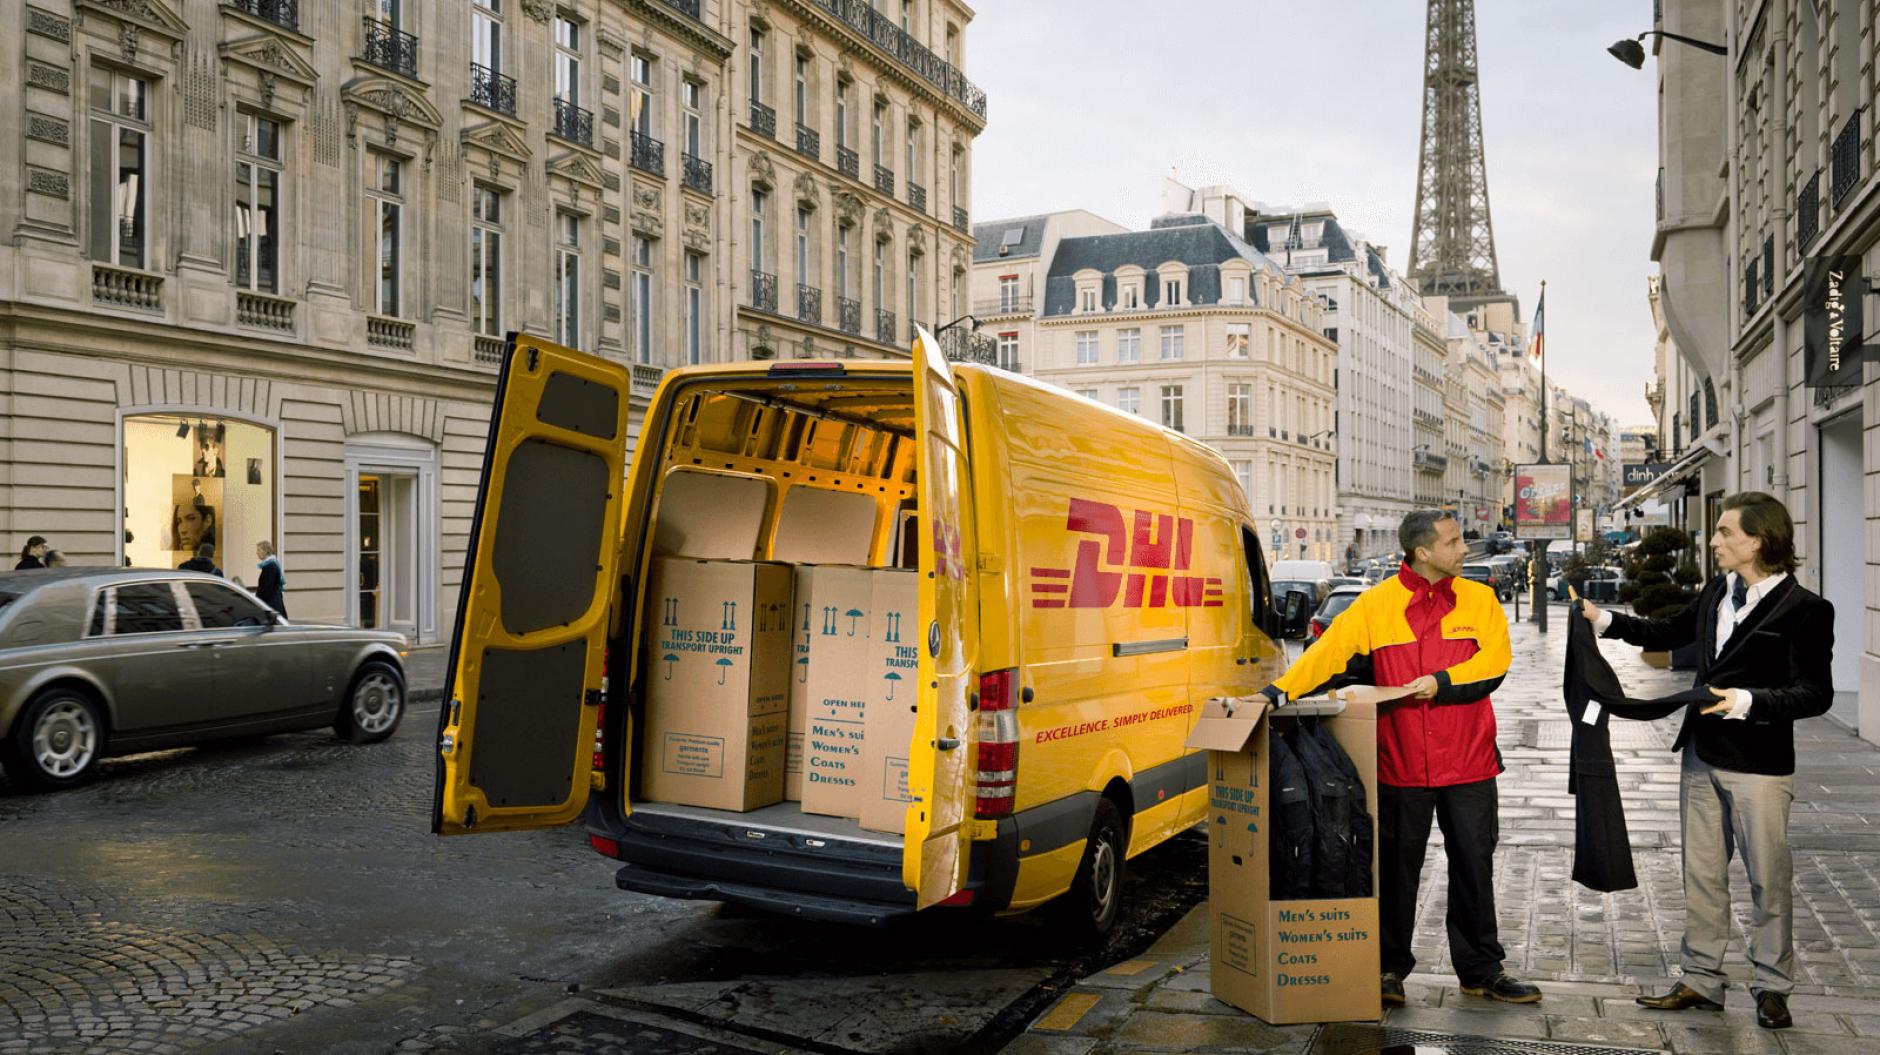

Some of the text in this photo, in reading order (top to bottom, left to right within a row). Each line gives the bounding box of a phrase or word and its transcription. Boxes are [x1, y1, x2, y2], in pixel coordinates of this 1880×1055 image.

[1825, 270, 1845, 313] Zadig
[1829, 319, 1844, 372] Voltaire
[1627, 467, 1654, 481] dinh
[1066, 497, 1206, 609] DHL
[671, 629, 735, 645] THIS SIDE UP
[662, 640, 744, 655] TRANSPORT UPRIGHT
[895, 645, 918, 659] THIS
[823, 698, 848, 707] OPEN
[812, 725, 845, 738] MEN'S
[1034, 719, 1110, 744] EXCELLENCE.
[1113, 711, 1149, 728] SIMPLY
[811, 740, 860, 755] WOMEN'S
[810, 756, 846, 769] COATS
[809, 772, 856, 786] DRESSES
[1229, 787, 1243, 801] SIDE
[1244, 789, 1255, 803] UP
[1279, 907, 1351, 922] MEN'S SUITS
[1278, 927, 1368, 943] WOMEN'S SUITS
[1277, 952, 1318, 965] COATS
[1277, 973, 1330, 987] DRESSES
